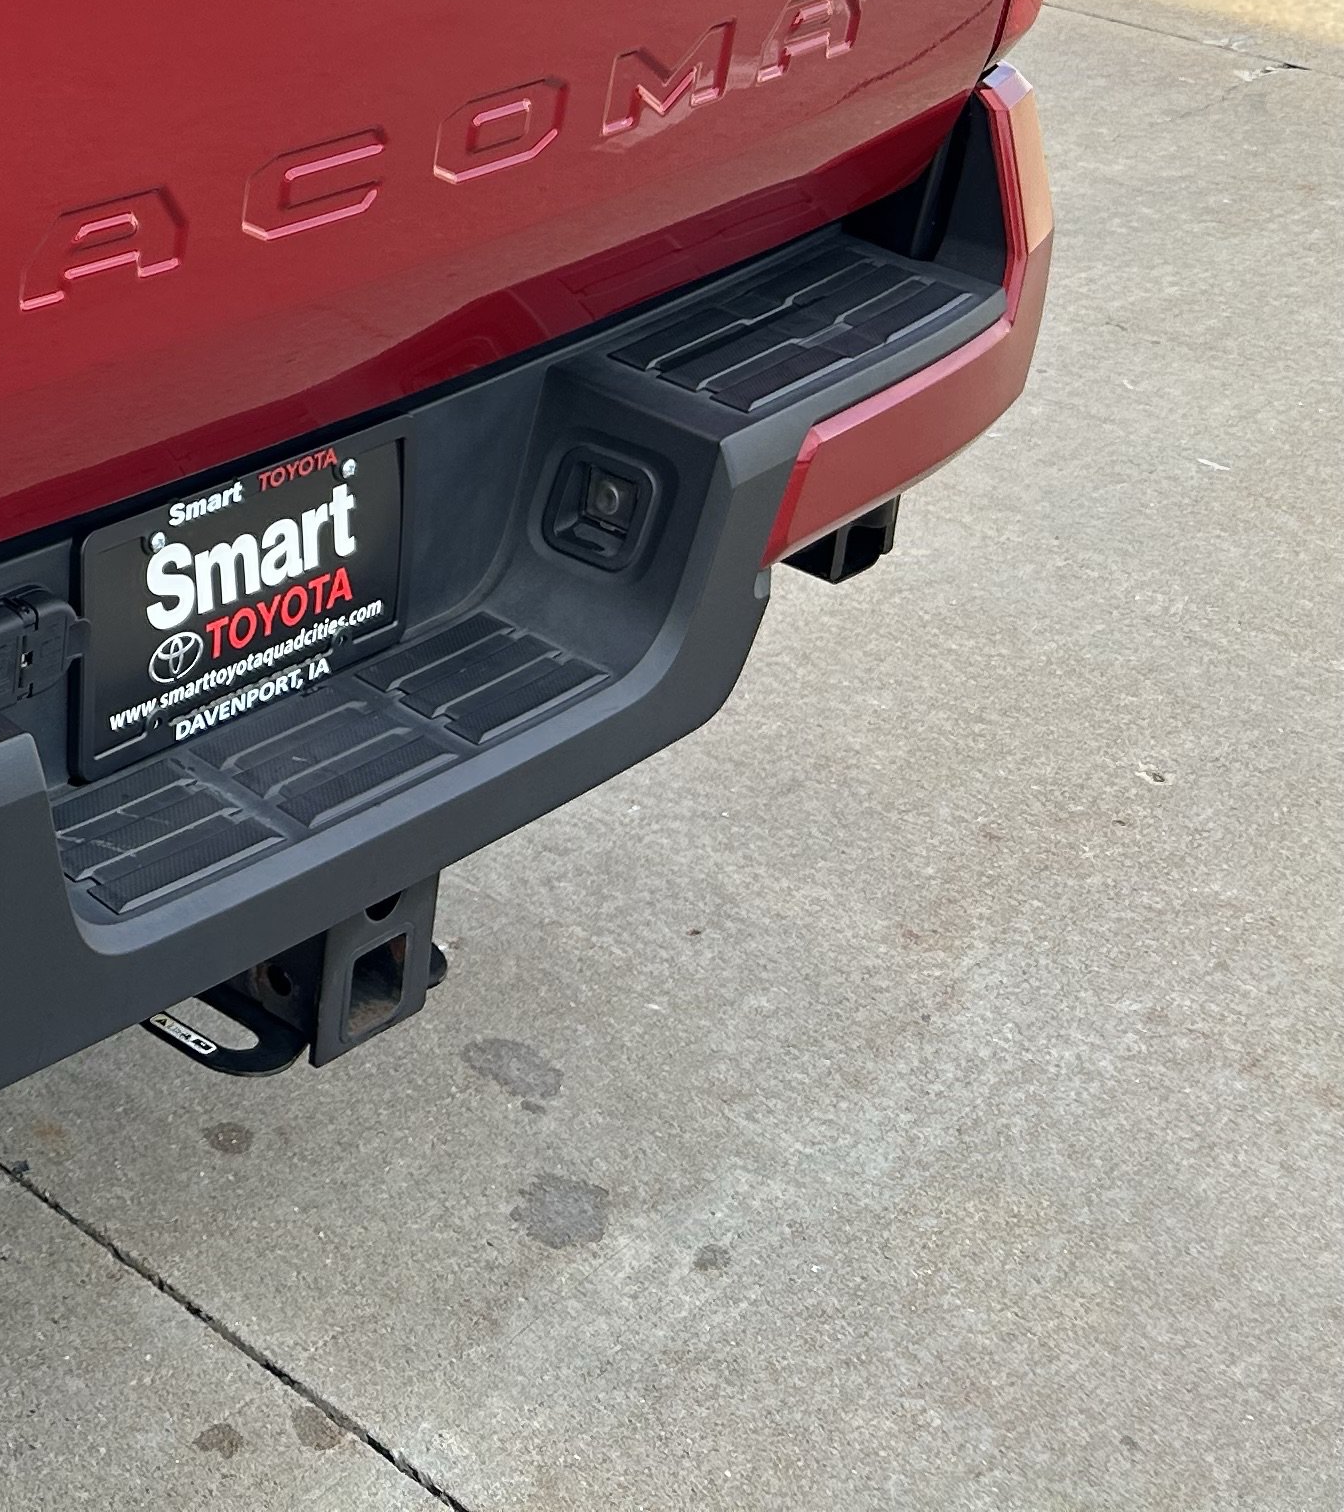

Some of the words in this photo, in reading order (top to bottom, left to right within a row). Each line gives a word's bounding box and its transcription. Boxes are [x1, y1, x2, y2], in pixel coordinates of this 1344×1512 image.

[169, 481, 243, 527] Smart
[258, 447, 338, 492] TOYOTA
[146, 483, 357, 631] Smart
[205, 567, 353, 659] TOYOTA
[109, 599, 382, 731] wwwsmarttoyotaquadcities.com
[175, 668, 304, 742] DAVENPORT,
[308, 657, 330, 681] IA
